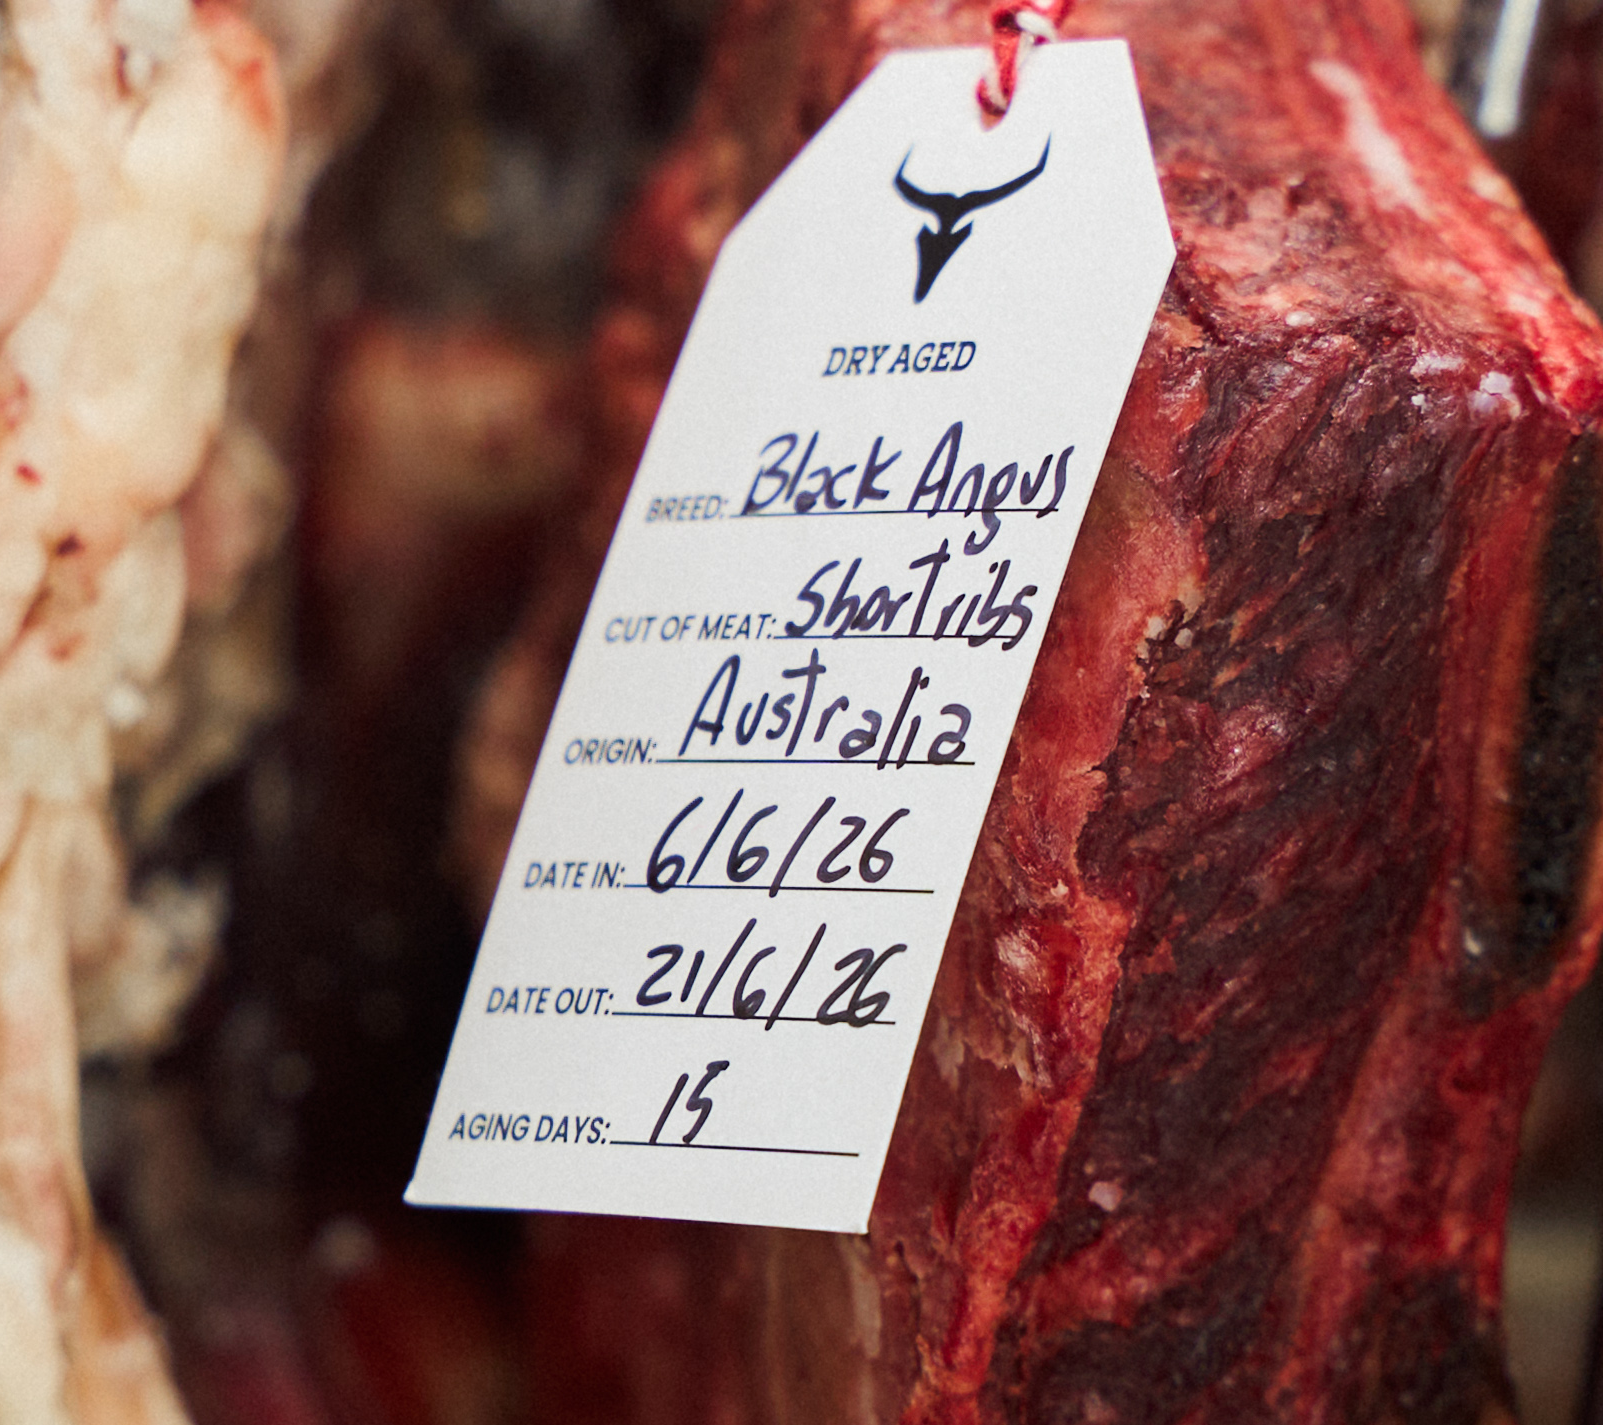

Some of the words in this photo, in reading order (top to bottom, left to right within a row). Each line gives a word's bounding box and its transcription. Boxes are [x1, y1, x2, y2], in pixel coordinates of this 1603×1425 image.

[821, 346, 892, 378] DRY
[893, 341, 977, 373] AGED
[644, 495, 729, 524] BREED:
[741, 430, 903, 516] Black
[907, 421, 1075, 555] Angus
[604, 616, 660, 643] CUT
[660, 616, 697, 641] OF
[698, 614, 776, 641] MEAT:
[563, 738, 658, 765] ORIGIN:
[678, 648, 972, 770] Australia
[523, 862, 589, 889] DATE
[590, 863, 625, 889] IN:
[646, 788, 911, 897] 6/6/26
[486, 986, 551, 1014] DATE
[554, 988, 615, 1017] OUT:
[636, 917, 908, 1031] 21/6/26
[449, 1113, 531, 1142] AGING
[533, 1116, 611, 1146] DAYS:
[649, 1060, 730, 1145] 15
